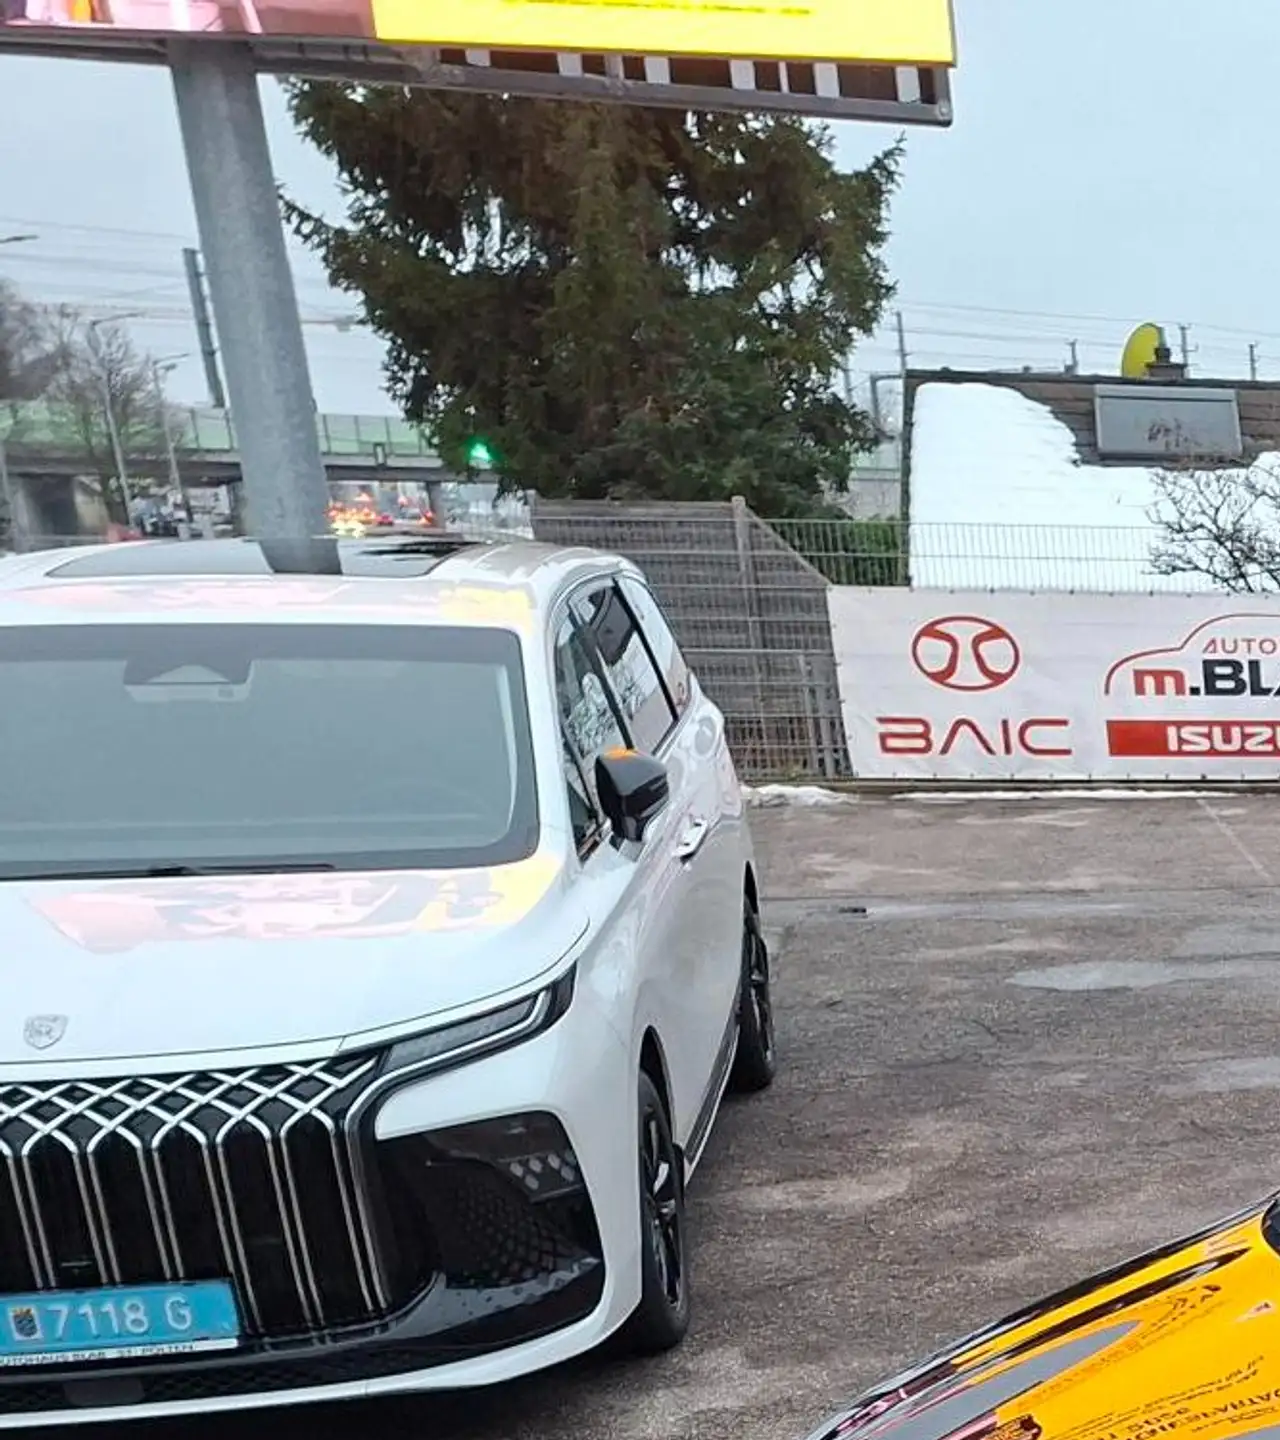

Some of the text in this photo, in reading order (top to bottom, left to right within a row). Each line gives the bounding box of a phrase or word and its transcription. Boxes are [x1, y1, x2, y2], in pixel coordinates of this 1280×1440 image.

[876, 716, 1073, 756] BAIC
[46, 1295, 193, 1341] 7118 G
